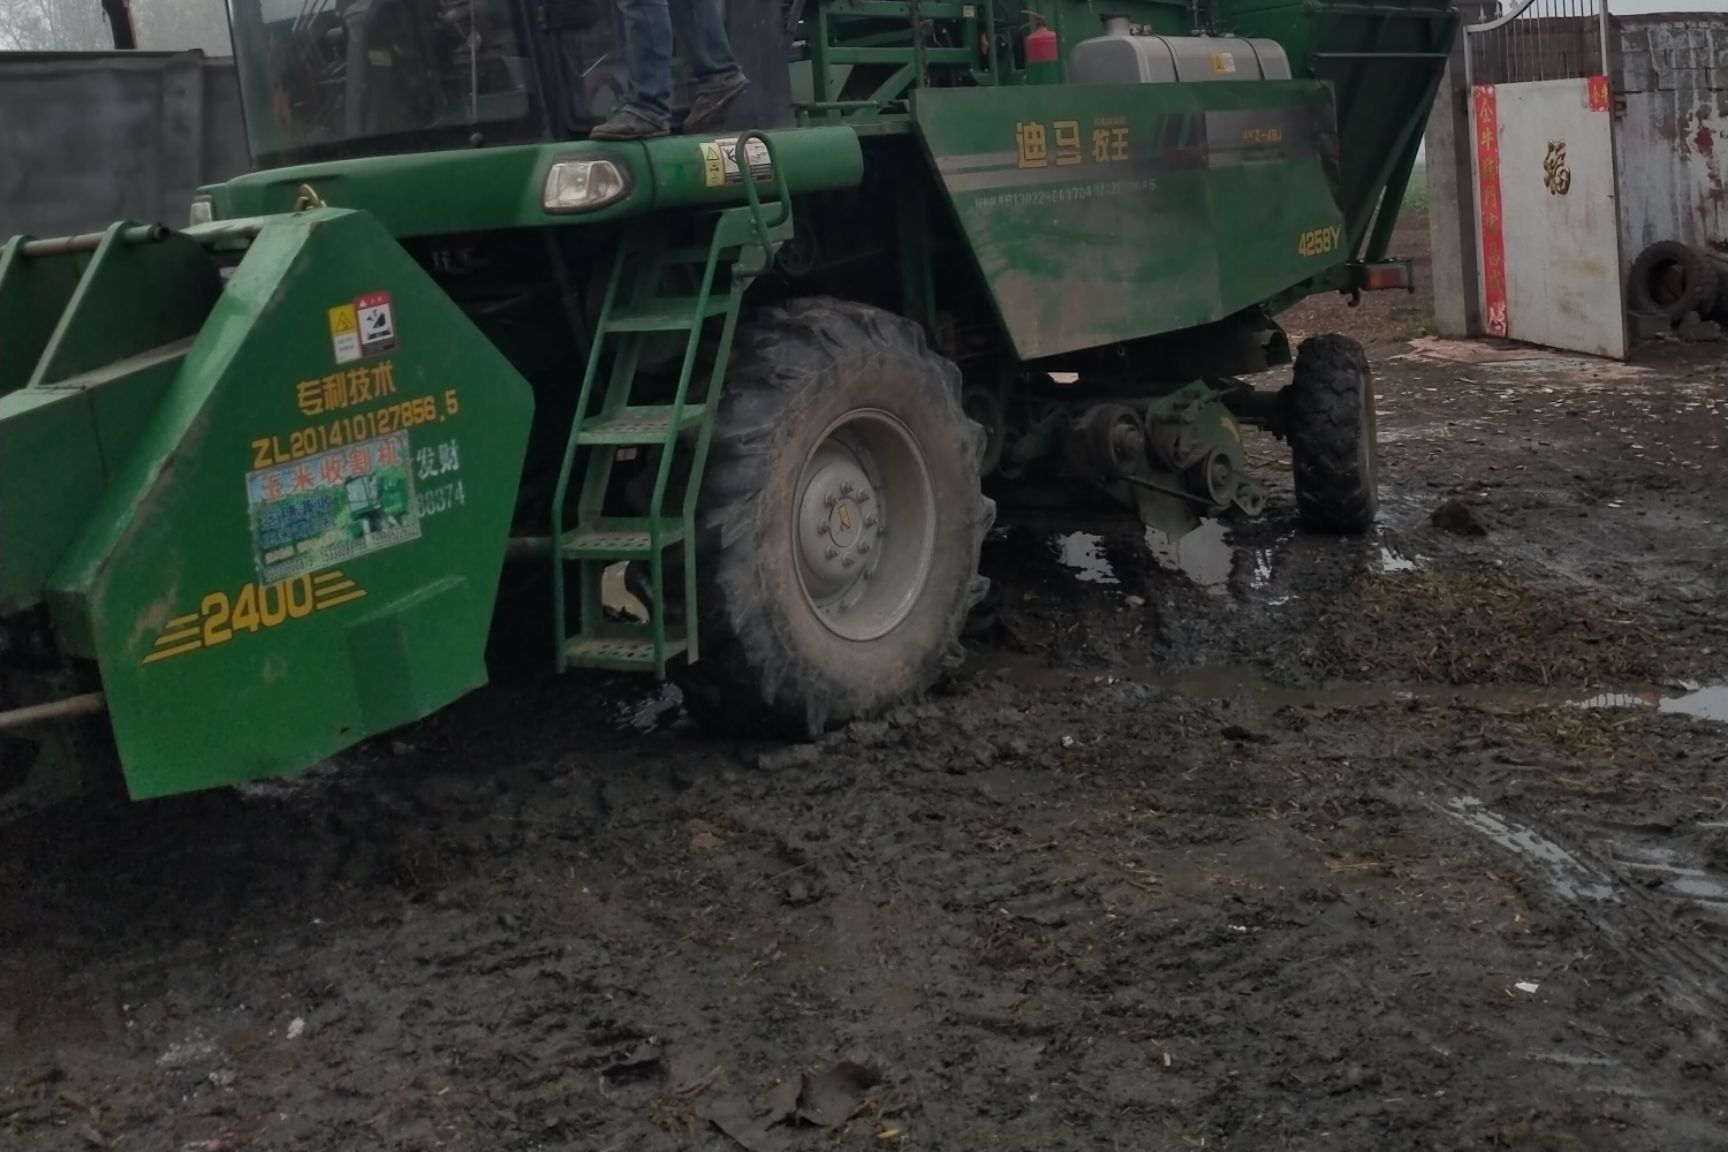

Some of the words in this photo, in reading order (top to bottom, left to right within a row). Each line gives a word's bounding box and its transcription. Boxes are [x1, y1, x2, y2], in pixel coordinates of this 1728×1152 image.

[1016, 120, 1083, 170] 迪马
[1092, 127, 1129, 164] 牧王
[1543, 135, 1571, 195] 福
[1298, 223, 1342, 257] 4258Y
[296, 362, 396, 417] 专利技术
[251, 389, 460, 469] ZL201410127856.5
[263, 437, 402, 503] 玉米收割机
[200, 574, 314, 647] 2400
